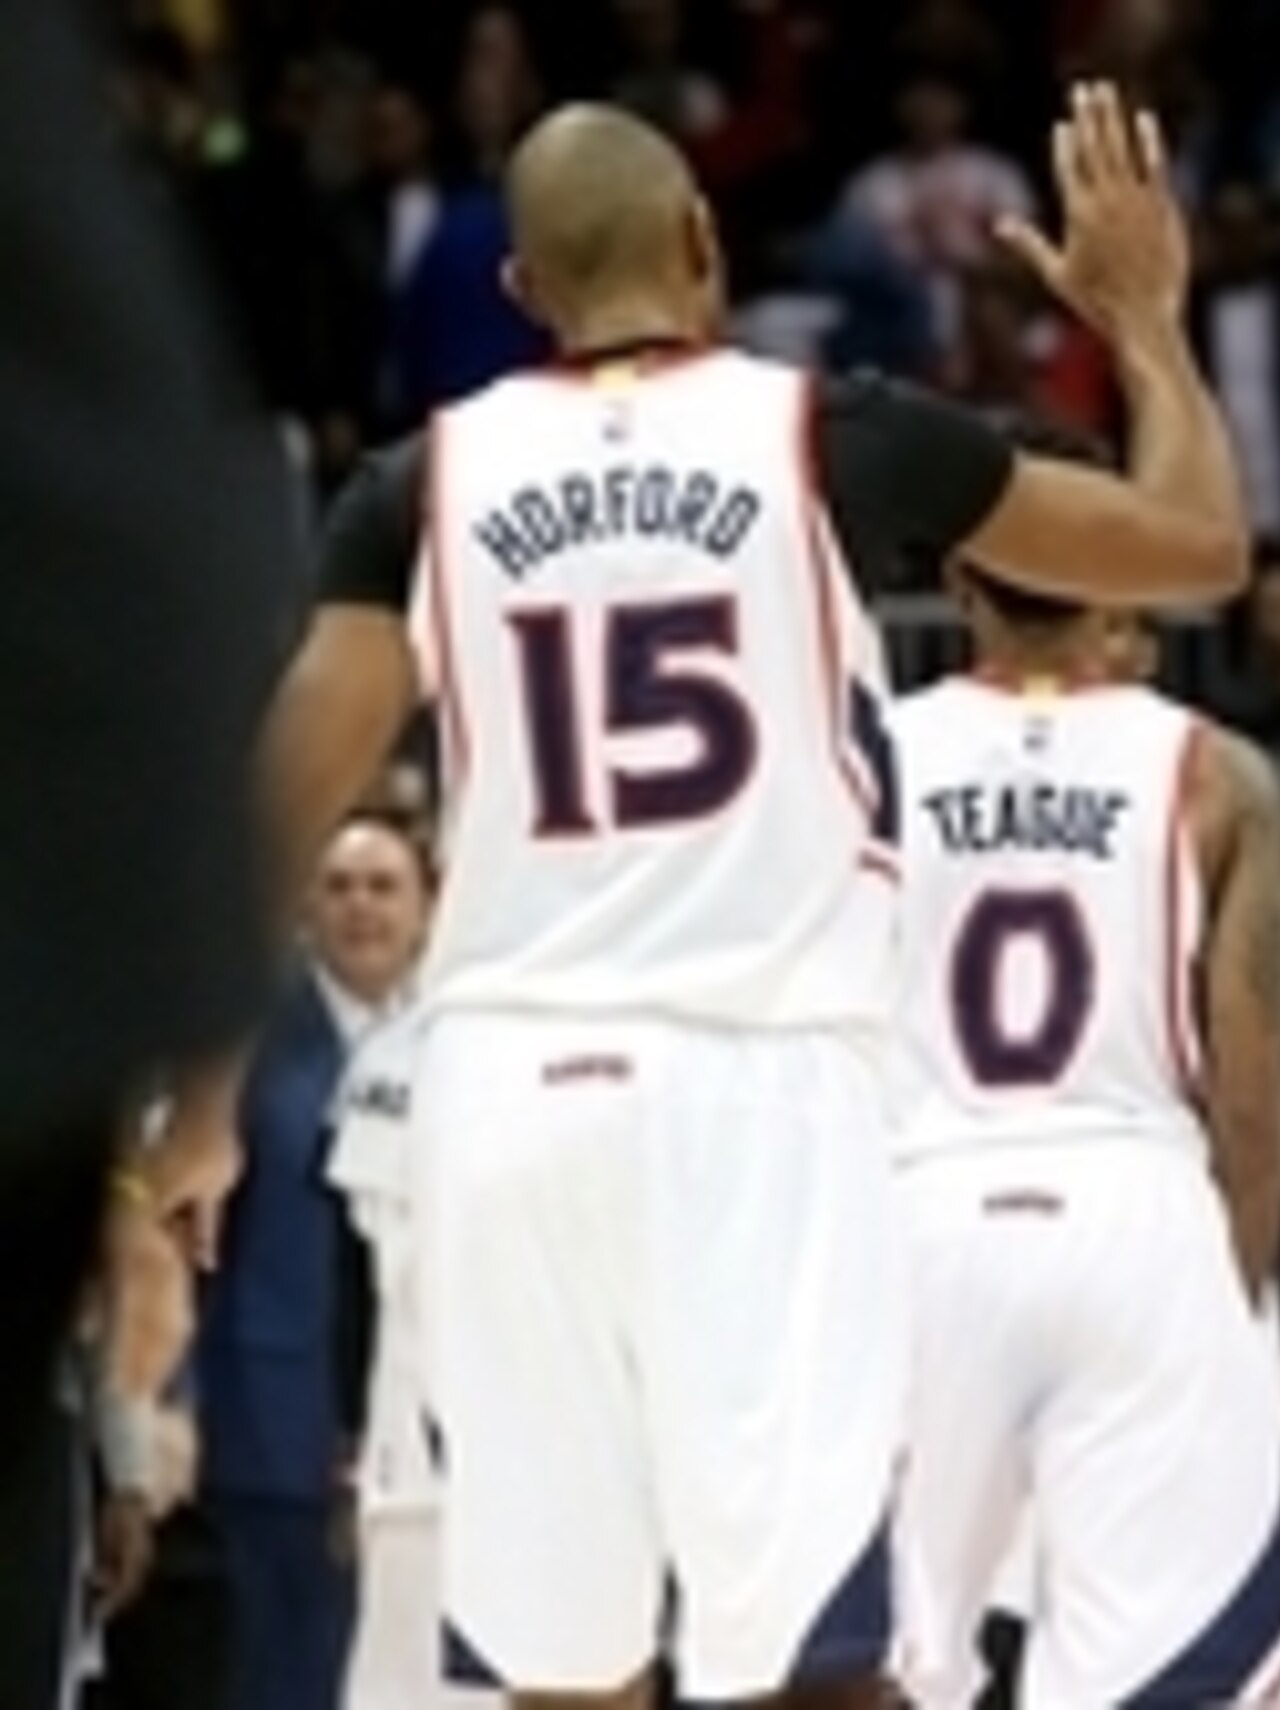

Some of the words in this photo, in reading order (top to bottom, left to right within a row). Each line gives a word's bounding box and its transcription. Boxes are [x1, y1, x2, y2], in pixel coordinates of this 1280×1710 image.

[471, 465, 763, 579] HORFORD
[500, 592, 760, 842] 15
[922, 784, 1131, 862] TEAGUE
[950, 884, 1097, 1088] 0
